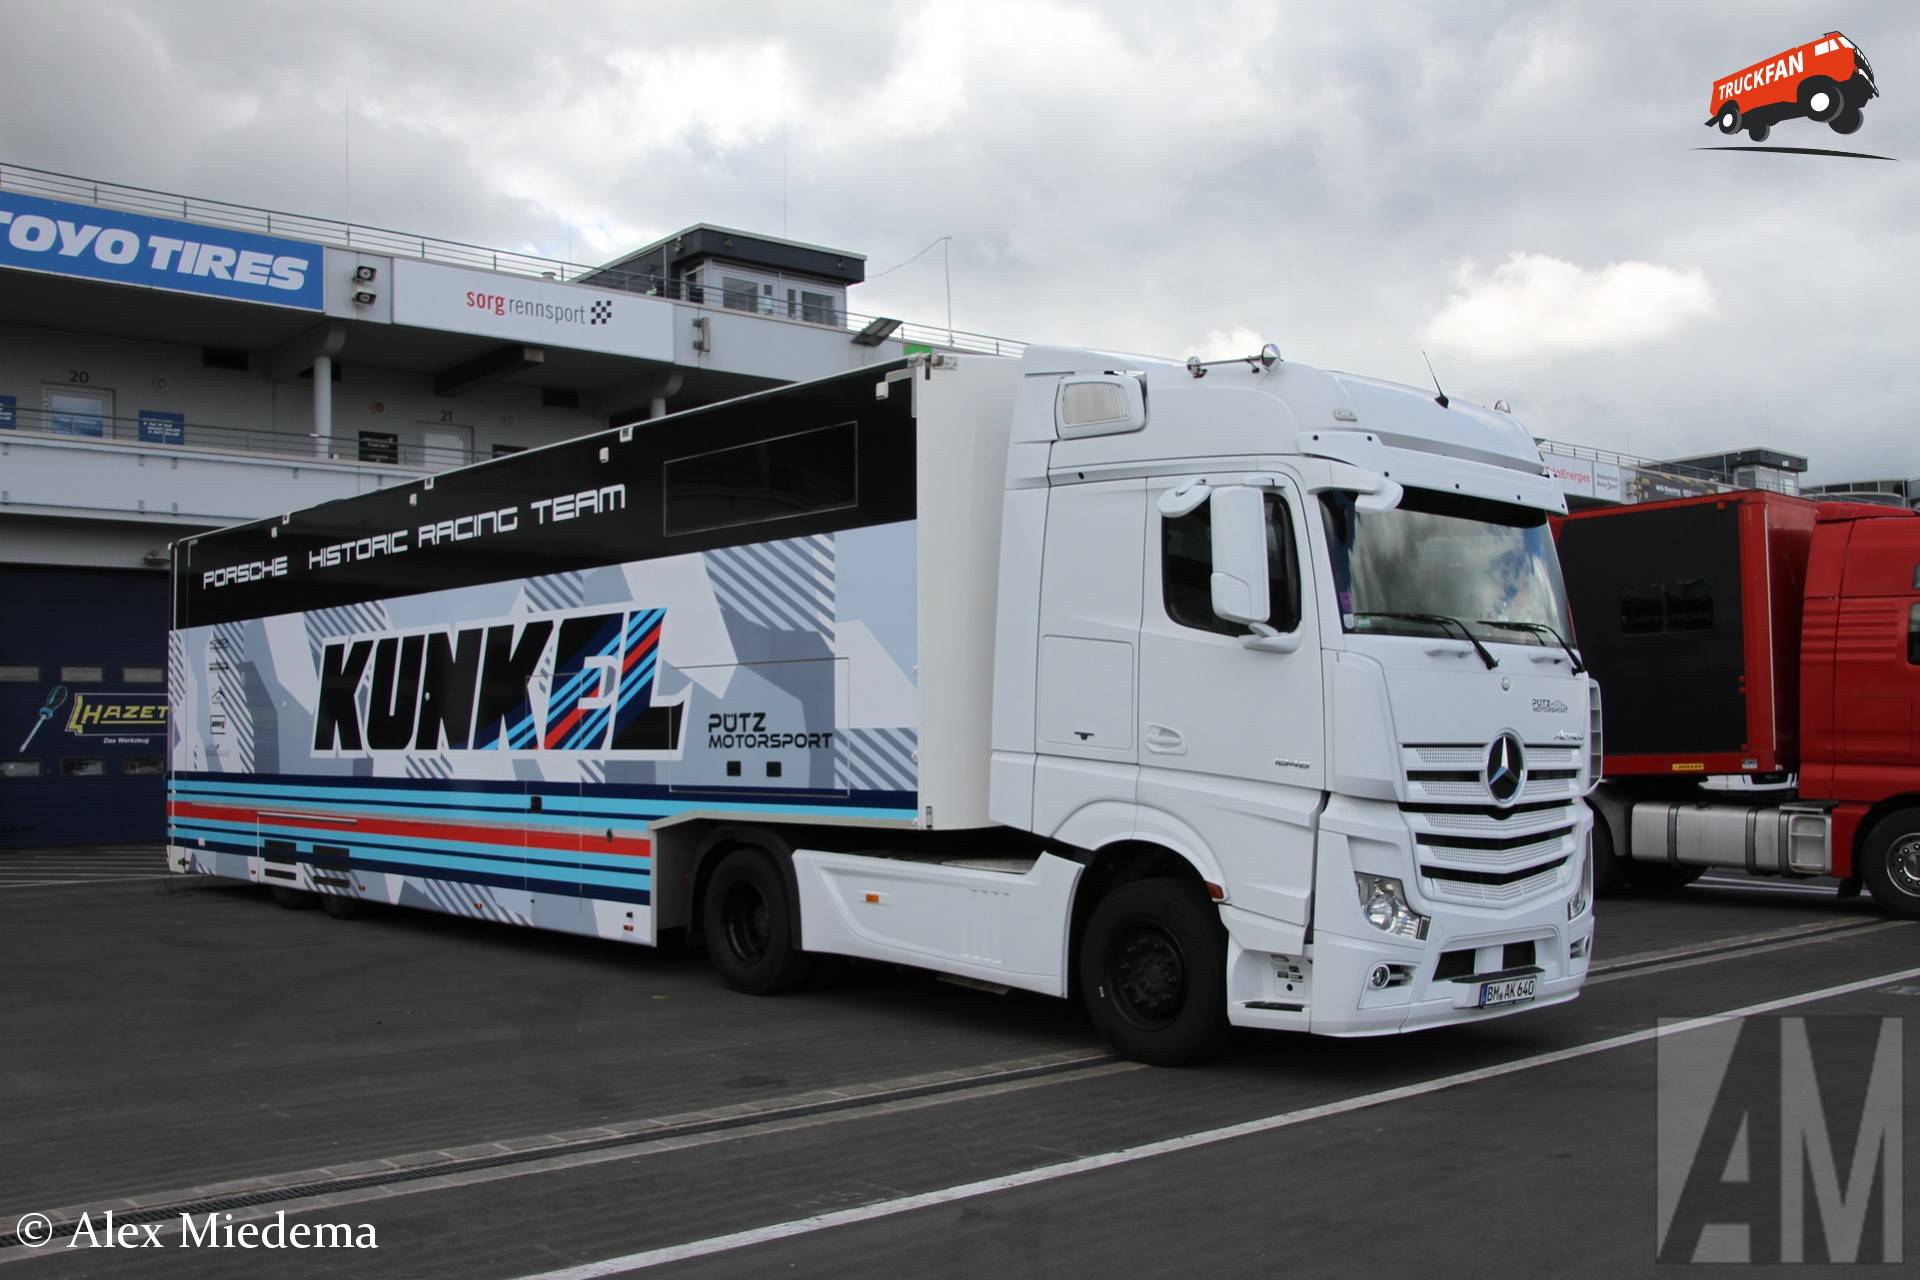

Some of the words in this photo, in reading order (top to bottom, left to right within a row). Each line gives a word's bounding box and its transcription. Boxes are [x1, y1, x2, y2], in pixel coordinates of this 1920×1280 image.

[0, 211, 140, 265] OYO
[148, 235, 309, 291] TIRES
[466, 291, 506, 316] sorg
[509, 299, 586, 325] rennsport
[69, 370, 89, 383] 20
[440, 410, 453, 422] 21
[203, 556, 288, 590] PORSCHE
[309, 530, 408, 570] HISTORIC
[418, 506, 518, 548] RACING
[530, 483, 625, 525] TEAM
[312, 606, 690, 758] KUNKEL
[81, 704, 168, 724] HAZET
[708, 712, 766, 733] PÜTZ
[708, 733, 833, 748] MOTORSPORT
[1488, 986, 1500, 1001] BM
[1504, 983, 1516, 999] AK
[1517, 980, 1534, 995] 640
